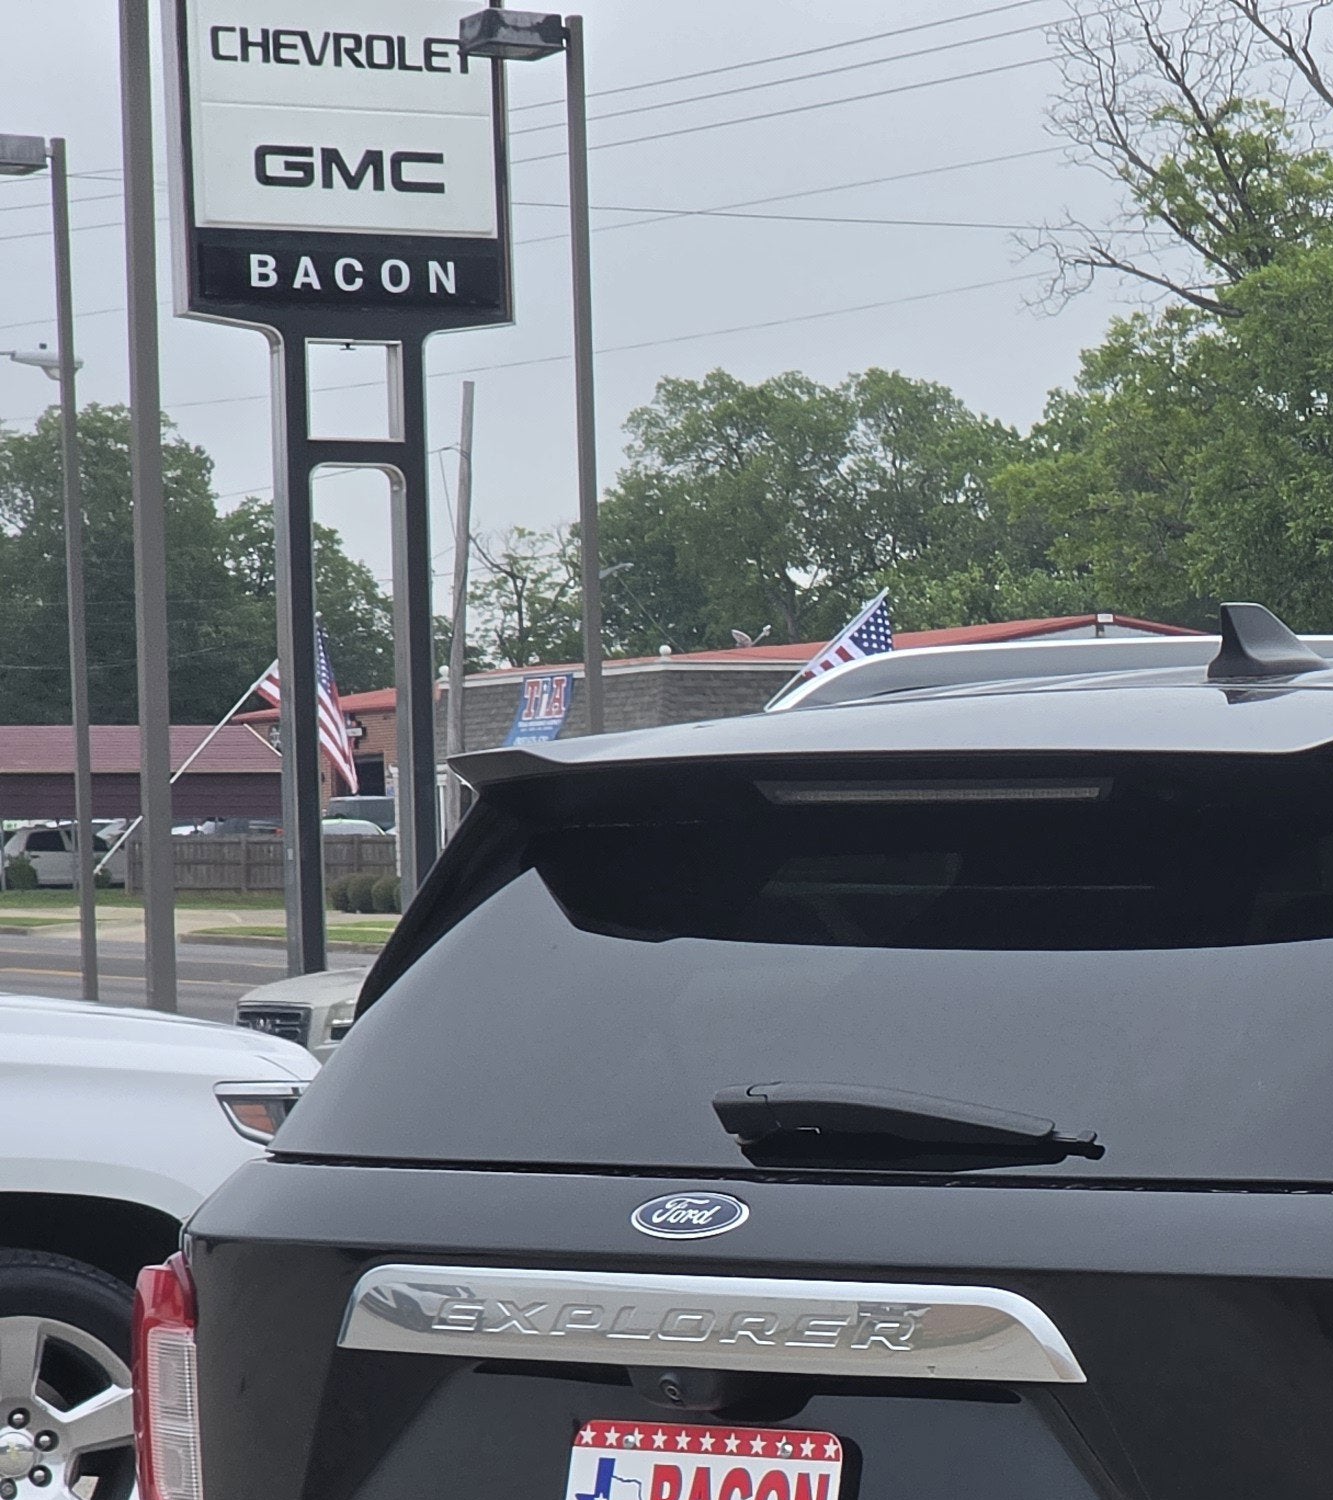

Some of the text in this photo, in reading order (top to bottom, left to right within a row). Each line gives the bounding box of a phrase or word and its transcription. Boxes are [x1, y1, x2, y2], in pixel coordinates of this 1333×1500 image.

[254, 144, 446, 194] GMC
[249, 254, 457, 294] BACON
[651, 1197, 722, 1227] Ford
[431, 1298, 921, 1351] EXPLORER
